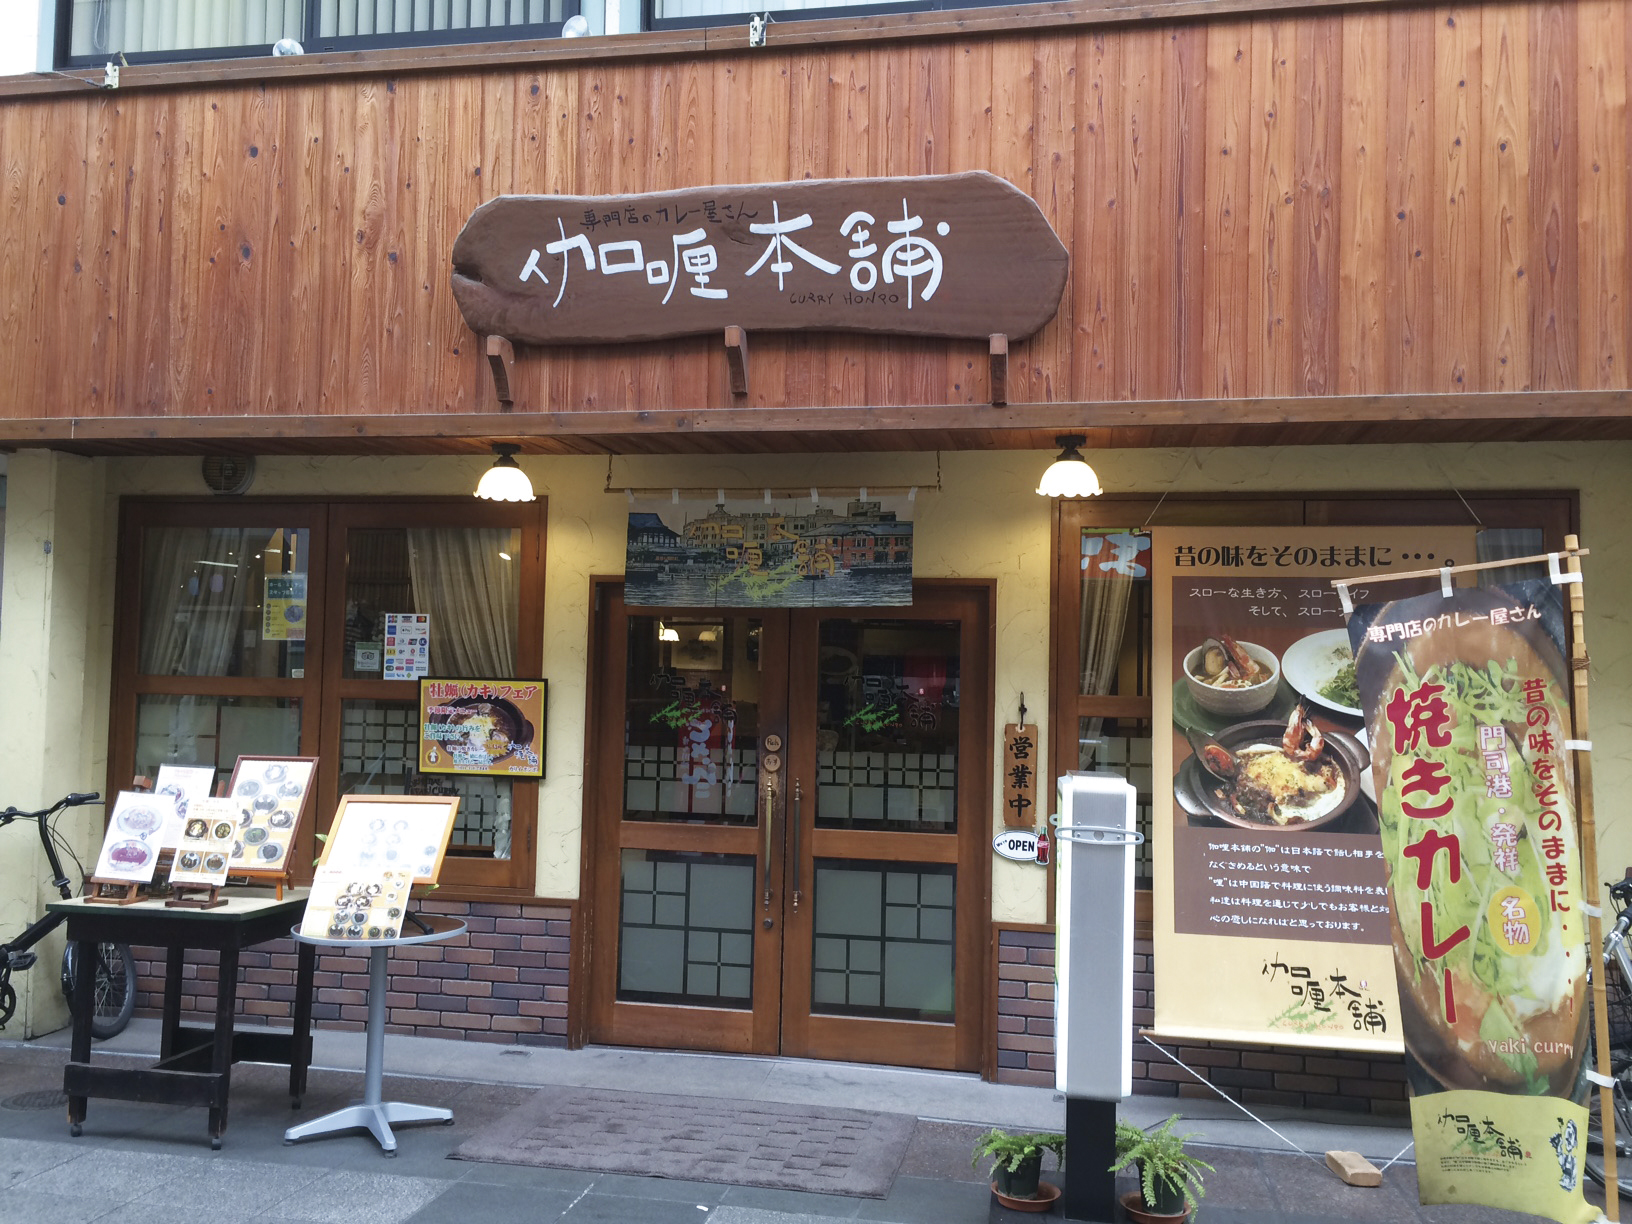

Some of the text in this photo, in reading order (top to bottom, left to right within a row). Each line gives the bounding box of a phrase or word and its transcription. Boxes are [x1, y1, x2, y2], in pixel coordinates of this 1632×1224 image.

[580, 200, 758, 232] 専門店のカレー屋さん
[789, 292, 899, 305] CURRY HONPO
[1189, 586, 1370, 600] スローな生き方、スローイフ
[1367, 603, 1542, 643] 専門店のカレー屋さん
[1008, 736, 1034, 818] 営業中
[1008, 839, 1035, 852] OPEN
[1386, 682, 1471, 1024] 焼きカレー
[1500, 896, 1531, 946] 名物
[1534, 1041, 1573, 1060] curry
